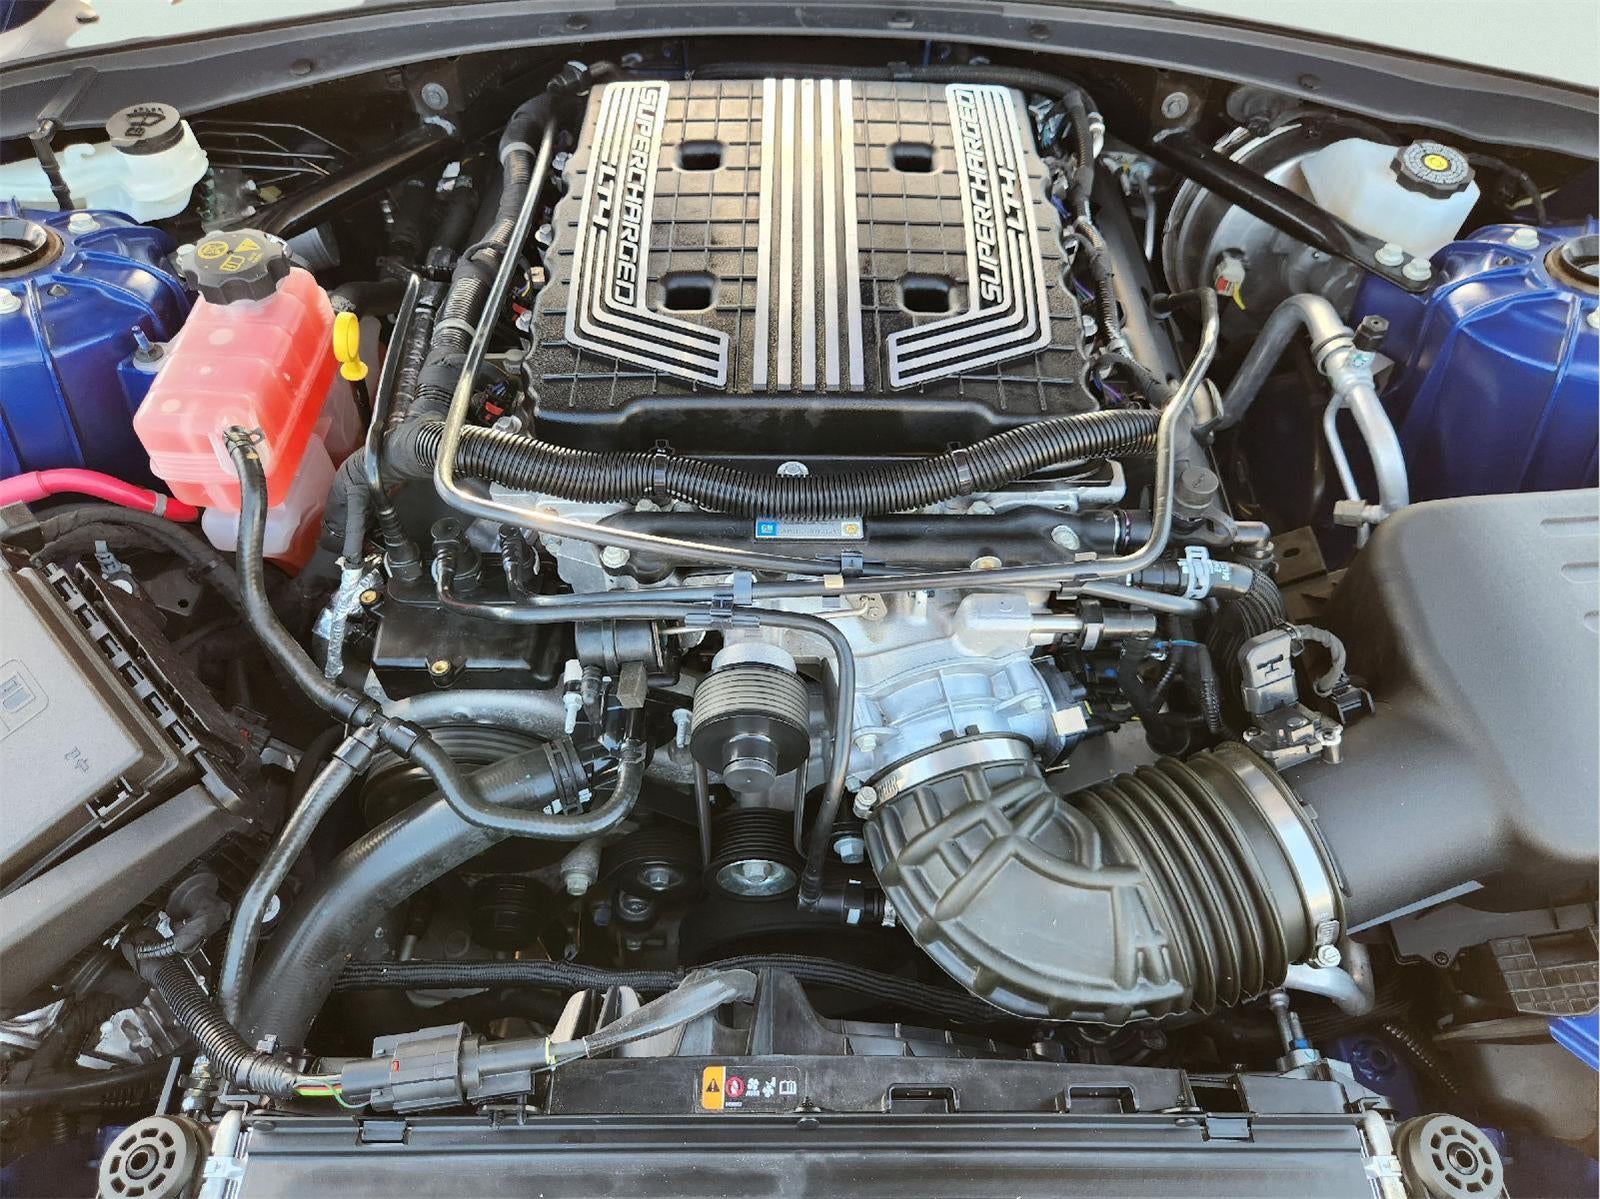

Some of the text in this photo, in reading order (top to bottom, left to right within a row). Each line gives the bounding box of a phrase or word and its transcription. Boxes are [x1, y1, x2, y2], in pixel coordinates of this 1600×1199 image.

[593, 162, 616, 230] LT4
[614, 86, 660, 305] SUPERCHARGED
[955, 89, 1002, 303] SUPERCHARGED
[999, 165, 1025, 233] LT4
[761, 524, 774, 534] GM
